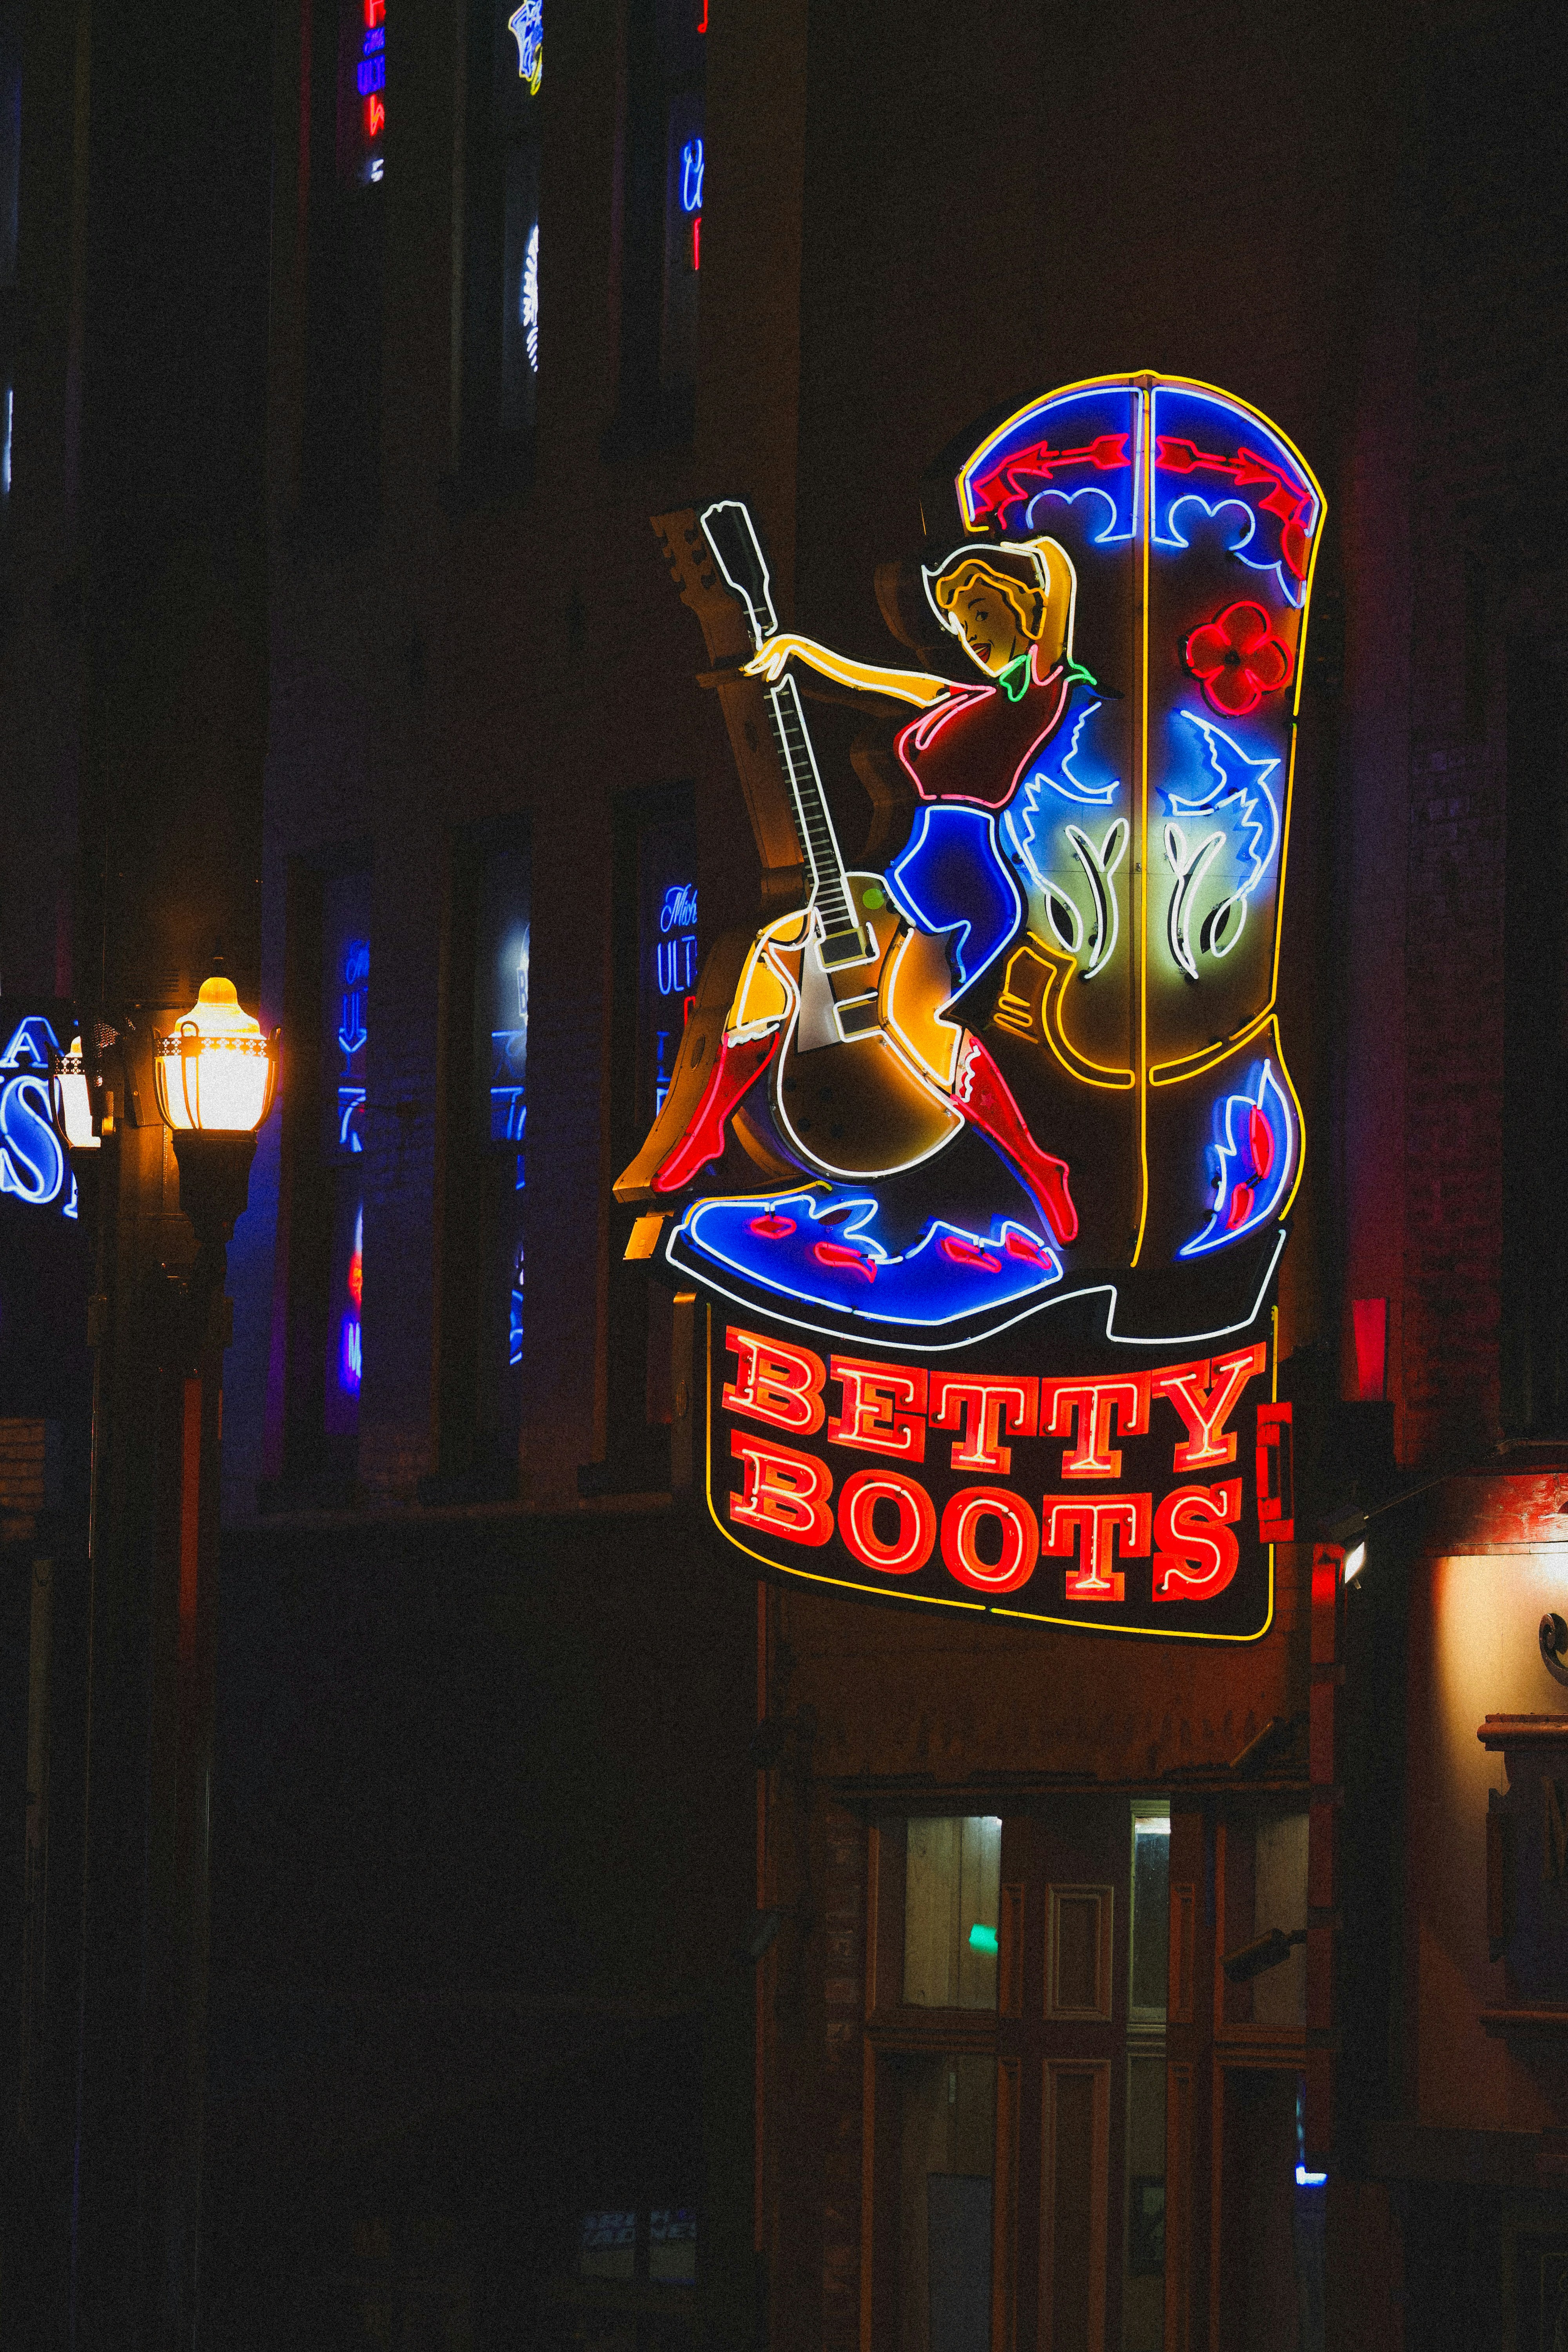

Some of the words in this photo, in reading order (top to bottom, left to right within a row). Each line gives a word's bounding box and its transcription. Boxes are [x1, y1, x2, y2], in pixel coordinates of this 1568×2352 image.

[657, 935, 698, 995] ULT
[722, 1325, 1266, 1479] BETTY
[730, 1429, 1242, 1602] BOOTS
